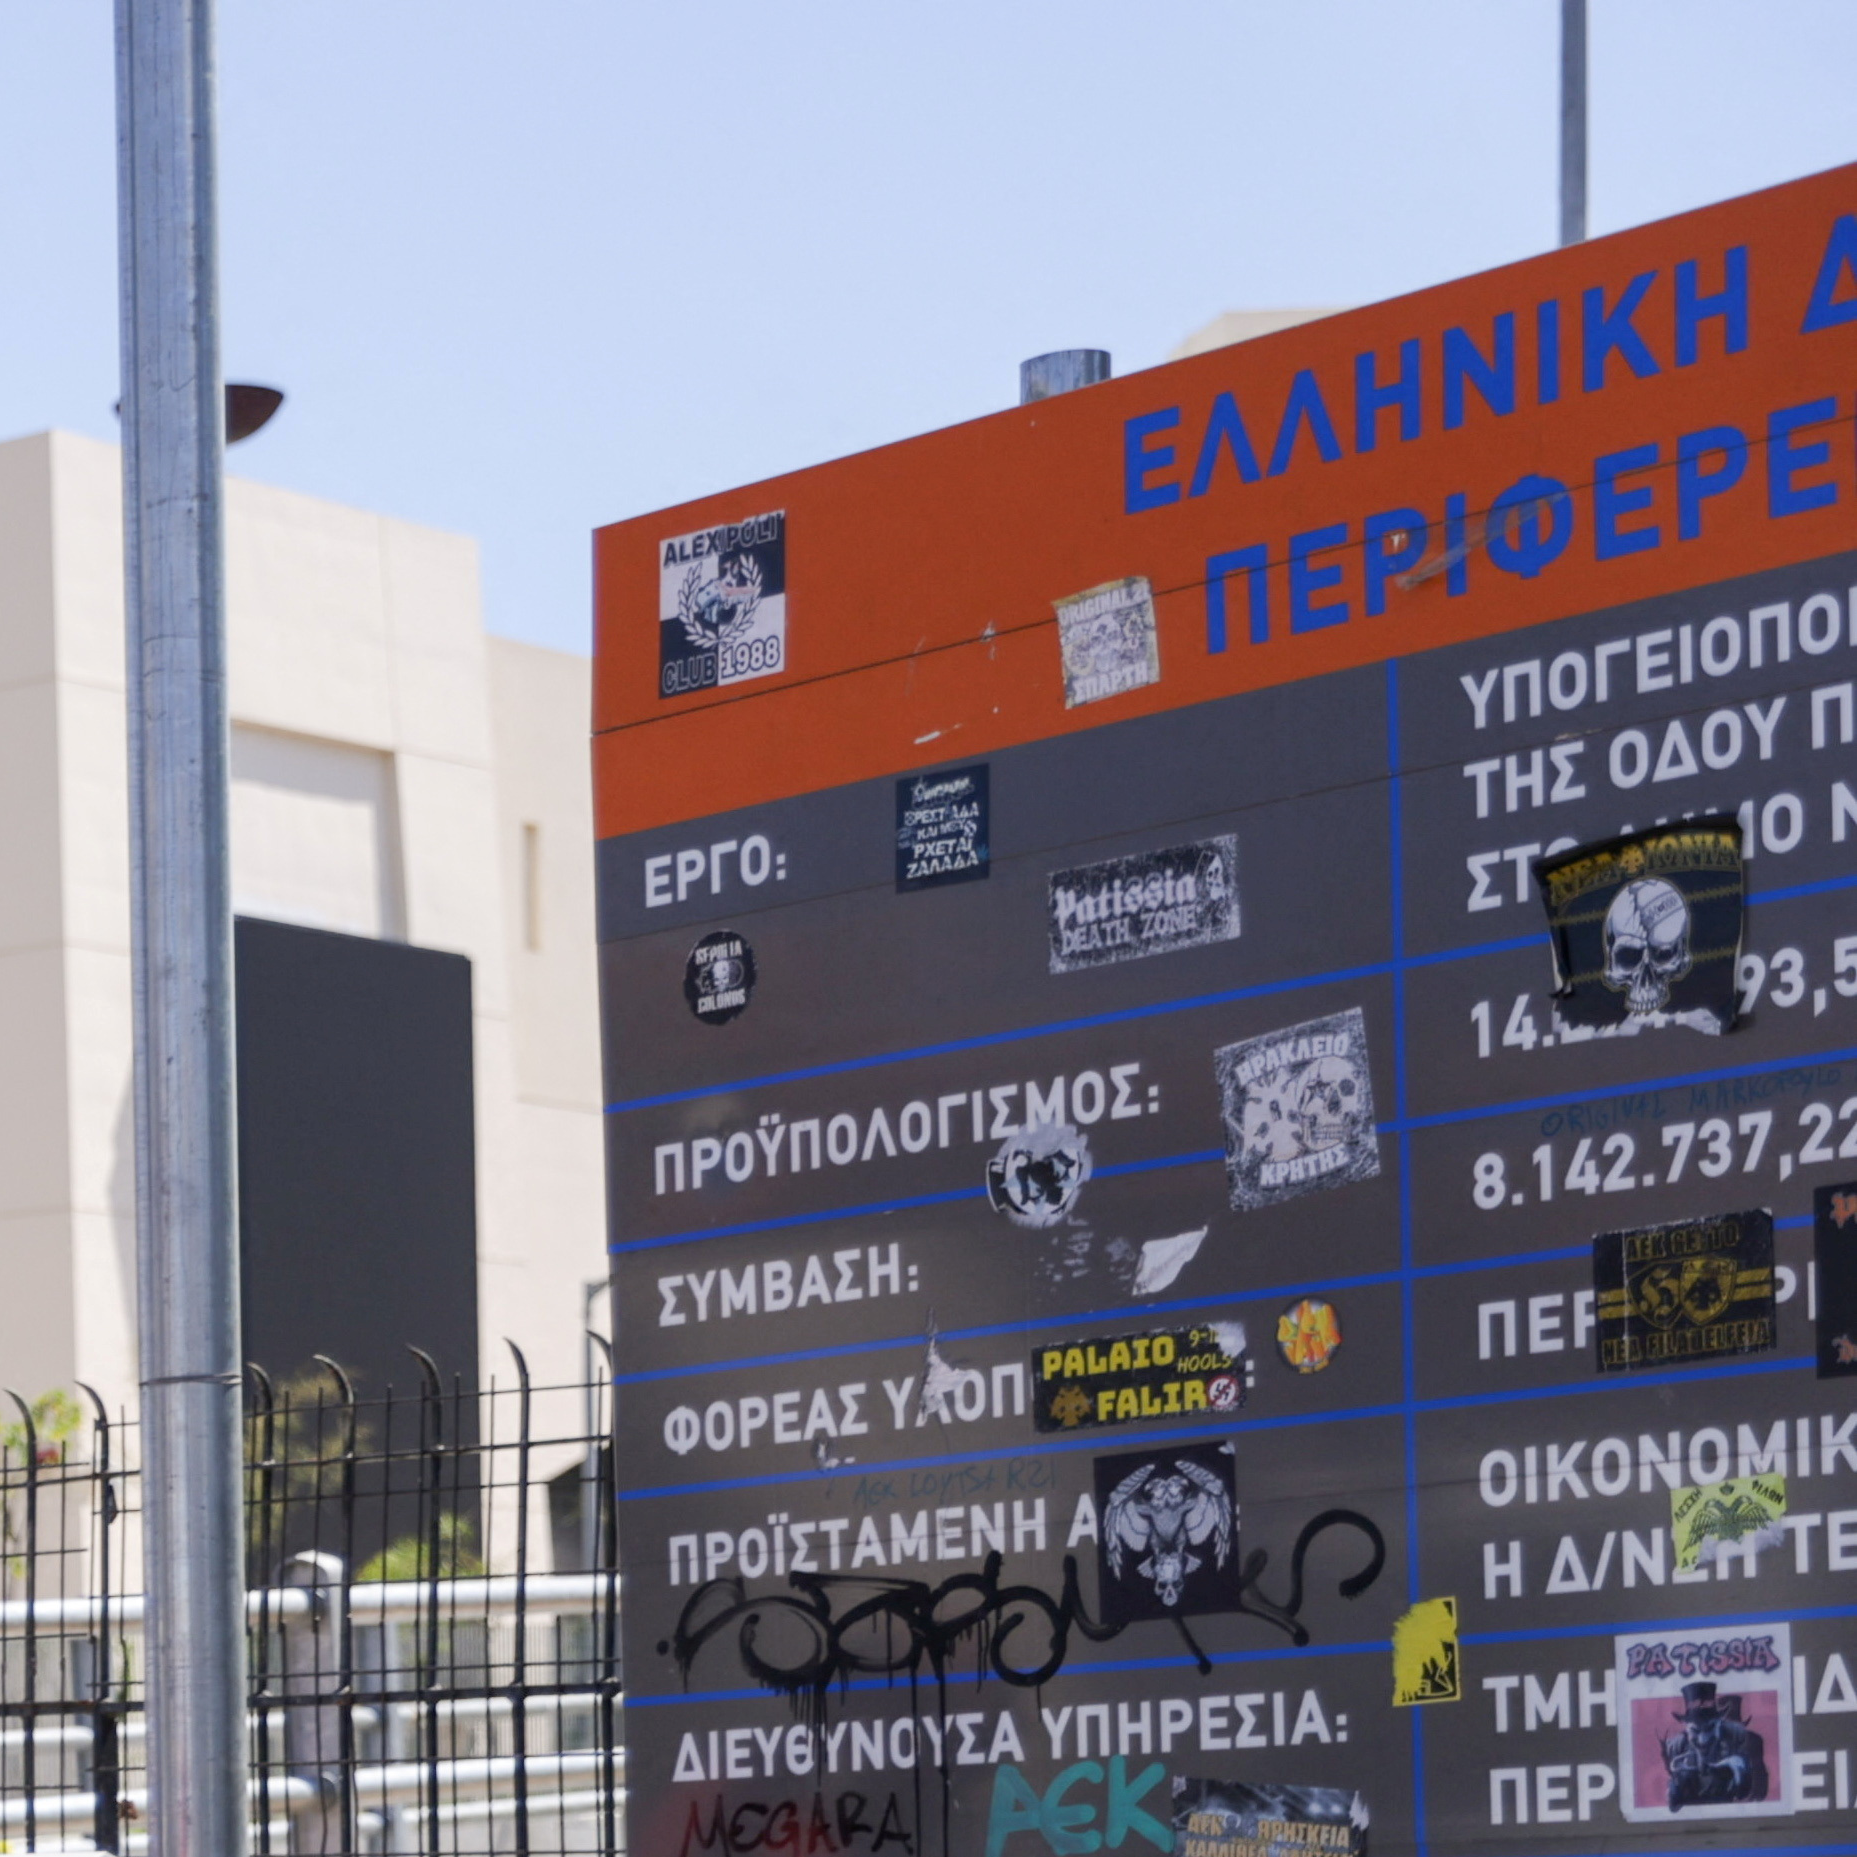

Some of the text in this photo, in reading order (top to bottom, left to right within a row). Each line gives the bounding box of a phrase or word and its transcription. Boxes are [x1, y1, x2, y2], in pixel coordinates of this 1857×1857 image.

[1124, 244, 1748, 515] ΕΛΛΗΝΙΚΗ
[662, 635, 781, 694] CLUB 1988
[1463, 741, 1586, 819] ΤΗΣ
[1609, 697, 1787, 789] ΟΔΟΥ
[645, 834, 786, 908] ΕΡΓΟ:
[1061, 902, 1198, 956] DEATH ZONE
[1236, 1033, 1349, 1086] ΗΡΑΚΛΕΙΟ
[655, 1062, 1160, 1195] ΠΡΟΫΠΟΛΟΓΙΣΜΟΣ:
[1260, 1144, 1349, 1186] ΚΡΗΤΗΣ
[657, 1243, 919, 1327] ΣΥΜΒΑΣΗ:
[1042, 1335, 1174, 1380] PALAIO
[664, 1383, 868, 1455] ΦΟΡΕΑΣ
[1479, 1412, 1857, 1507] ΟΙΚΟΝΟΜΙΚ
[669, 1498, 1047, 1586] ΠΡΟΪΣΤΑΜΕΝΗ
[1484, 1541, 1523, 1600] Η
[1626, 1635, 1781, 1680] PATISSIA
[672, 1689, 1349, 1782] ΔΙΕΥΘΥΝΟΥΣΑ ΥΠΗΡΕΣΙΑ:
